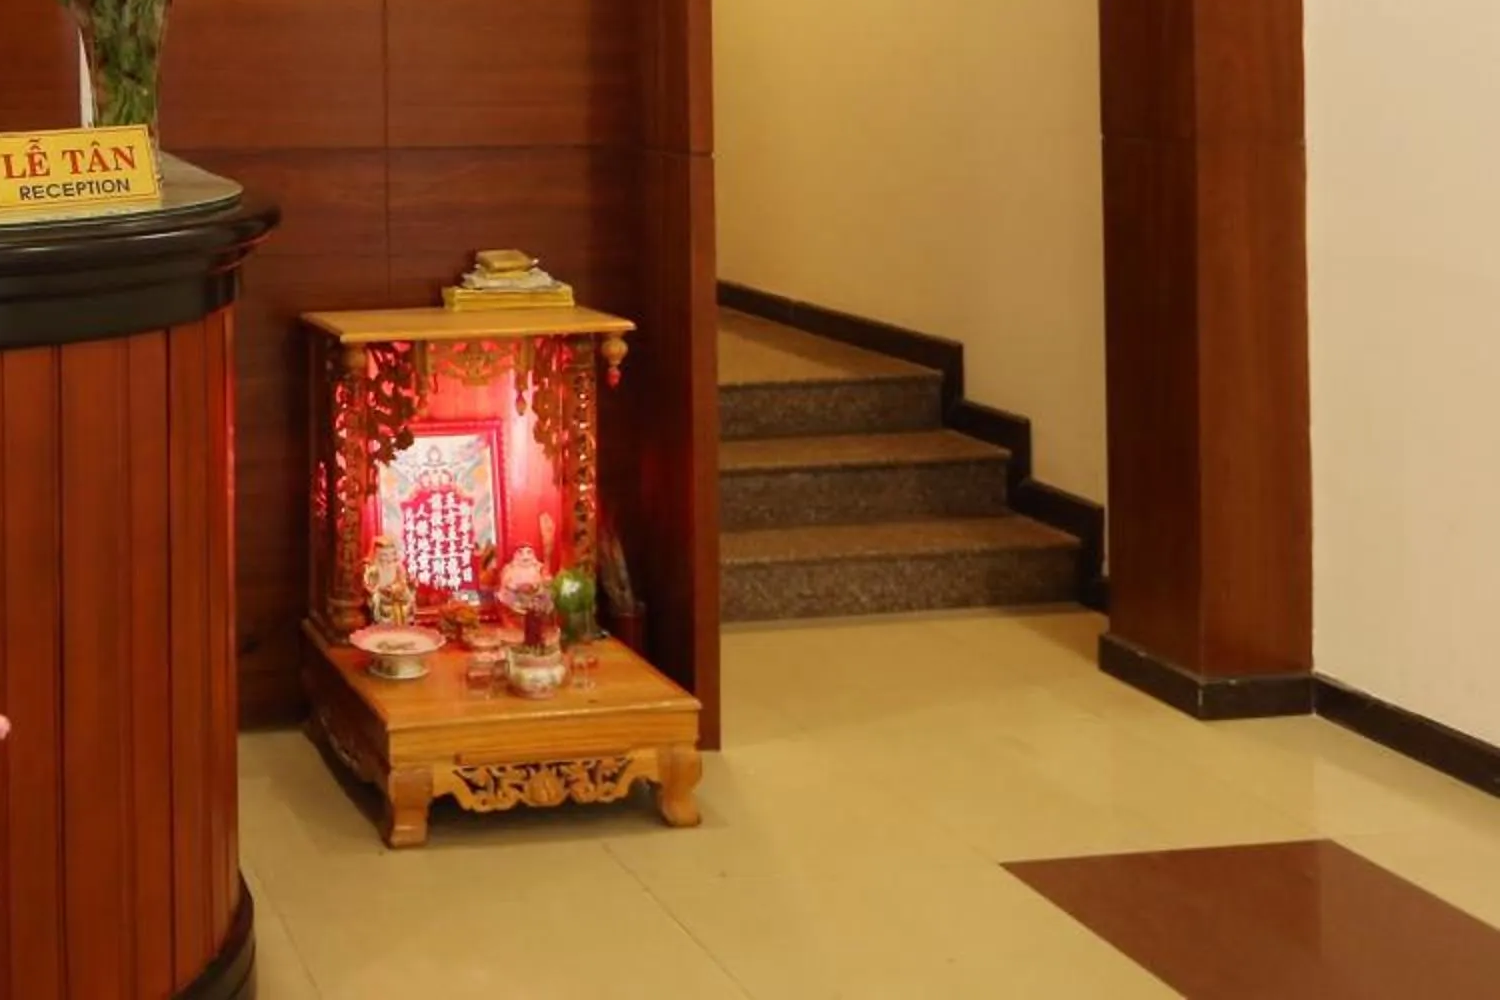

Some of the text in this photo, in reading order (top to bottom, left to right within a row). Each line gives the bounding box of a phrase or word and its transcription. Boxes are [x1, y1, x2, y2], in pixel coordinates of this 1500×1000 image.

[0, 138, 137, 179] LỄ TÂN
[19, 177, 131, 201] RECEPTION
